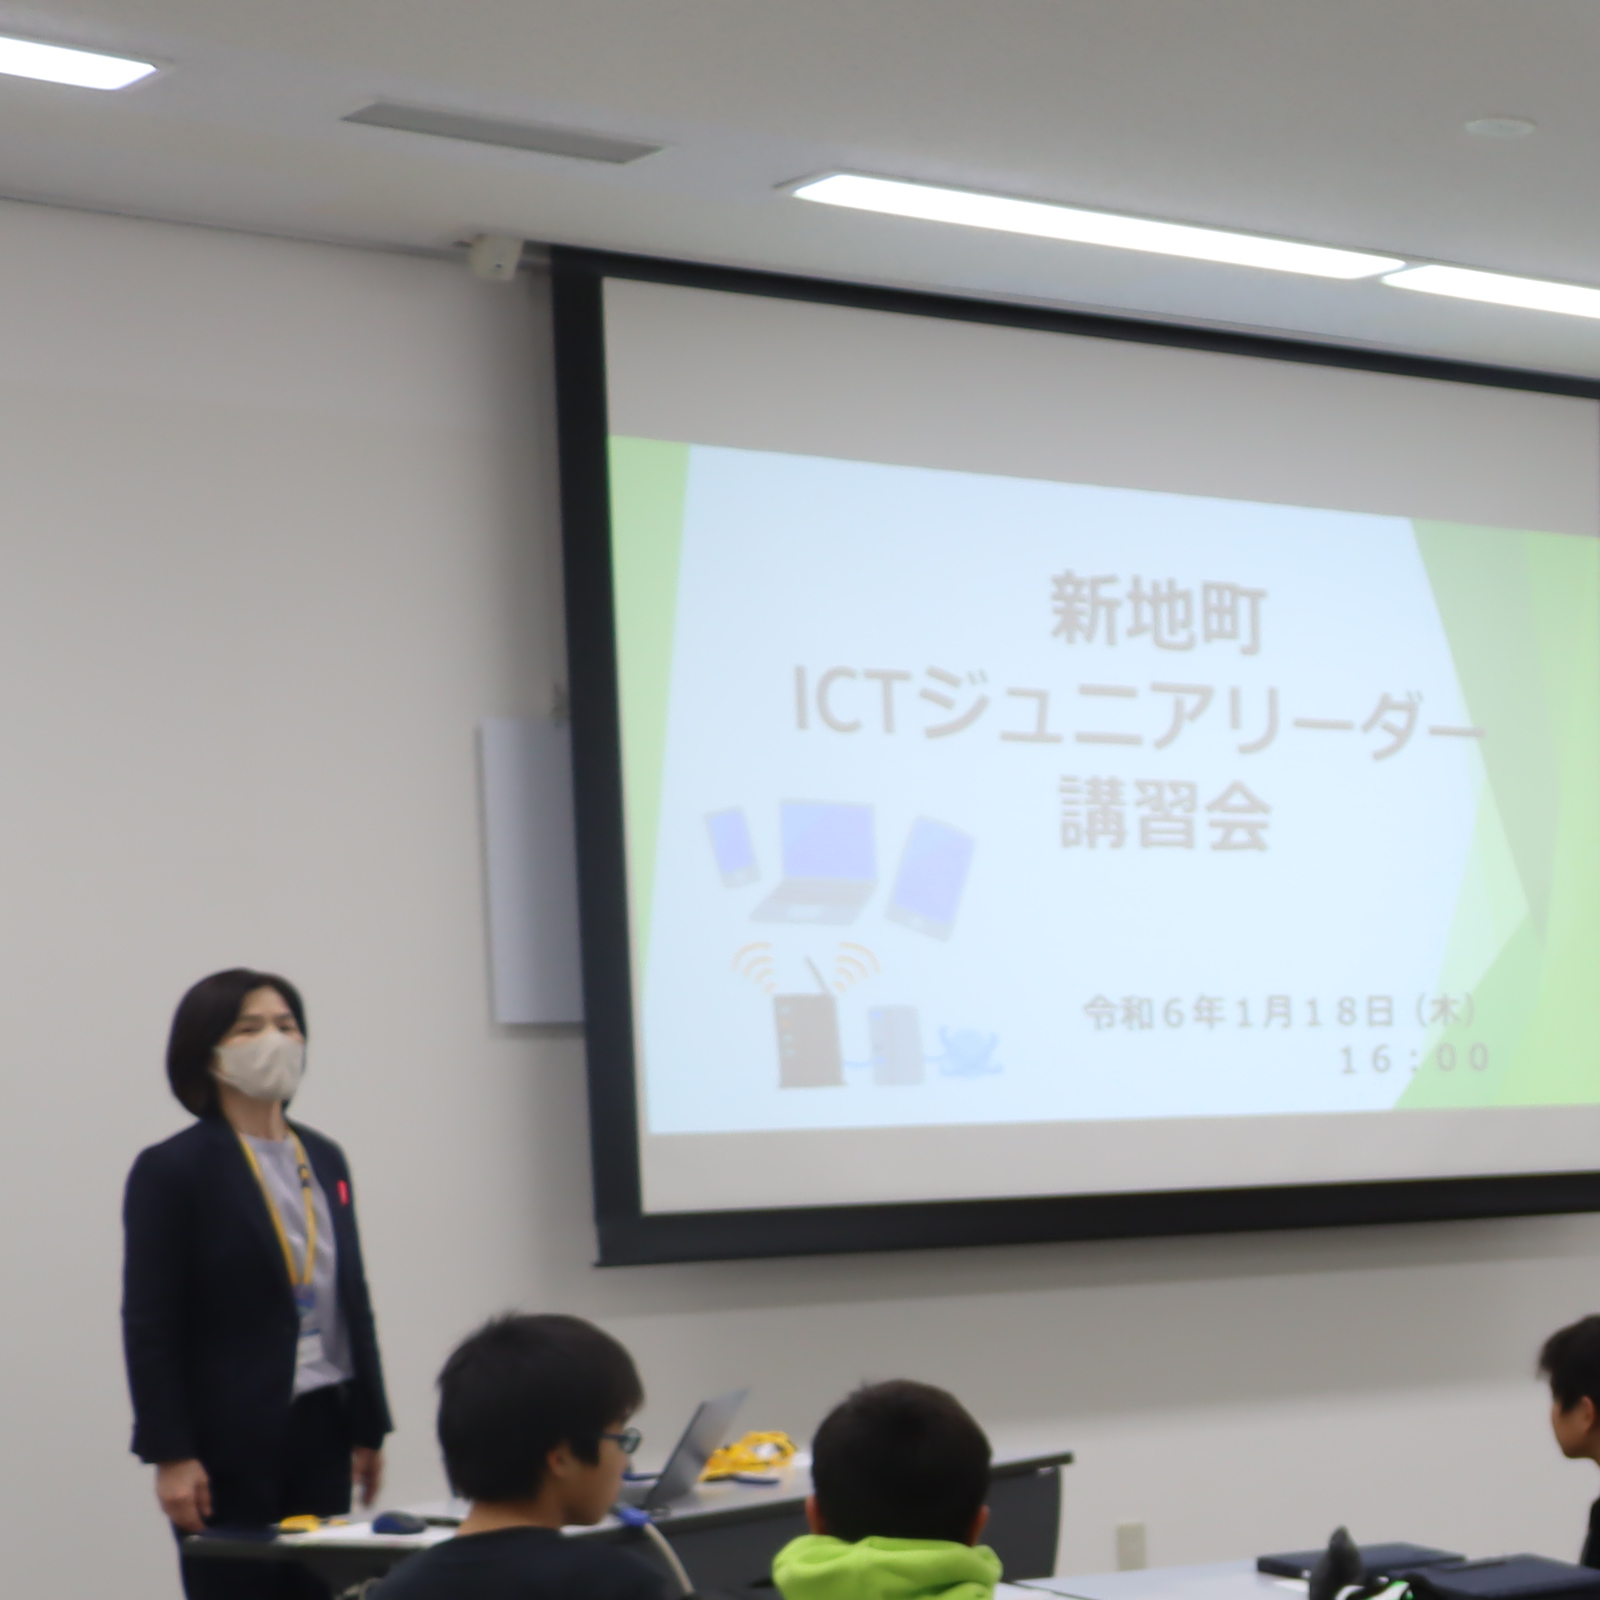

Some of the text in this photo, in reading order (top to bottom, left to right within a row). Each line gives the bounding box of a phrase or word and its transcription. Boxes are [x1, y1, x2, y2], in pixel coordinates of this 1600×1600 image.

[1048, 568, 1269, 657] 新地町
[792, 663, 1487, 763] ICTジュニアリーダー
[1057, 774, 1273, 855] 講習会
[1340, 1041, 1491, 1077] 16:00
